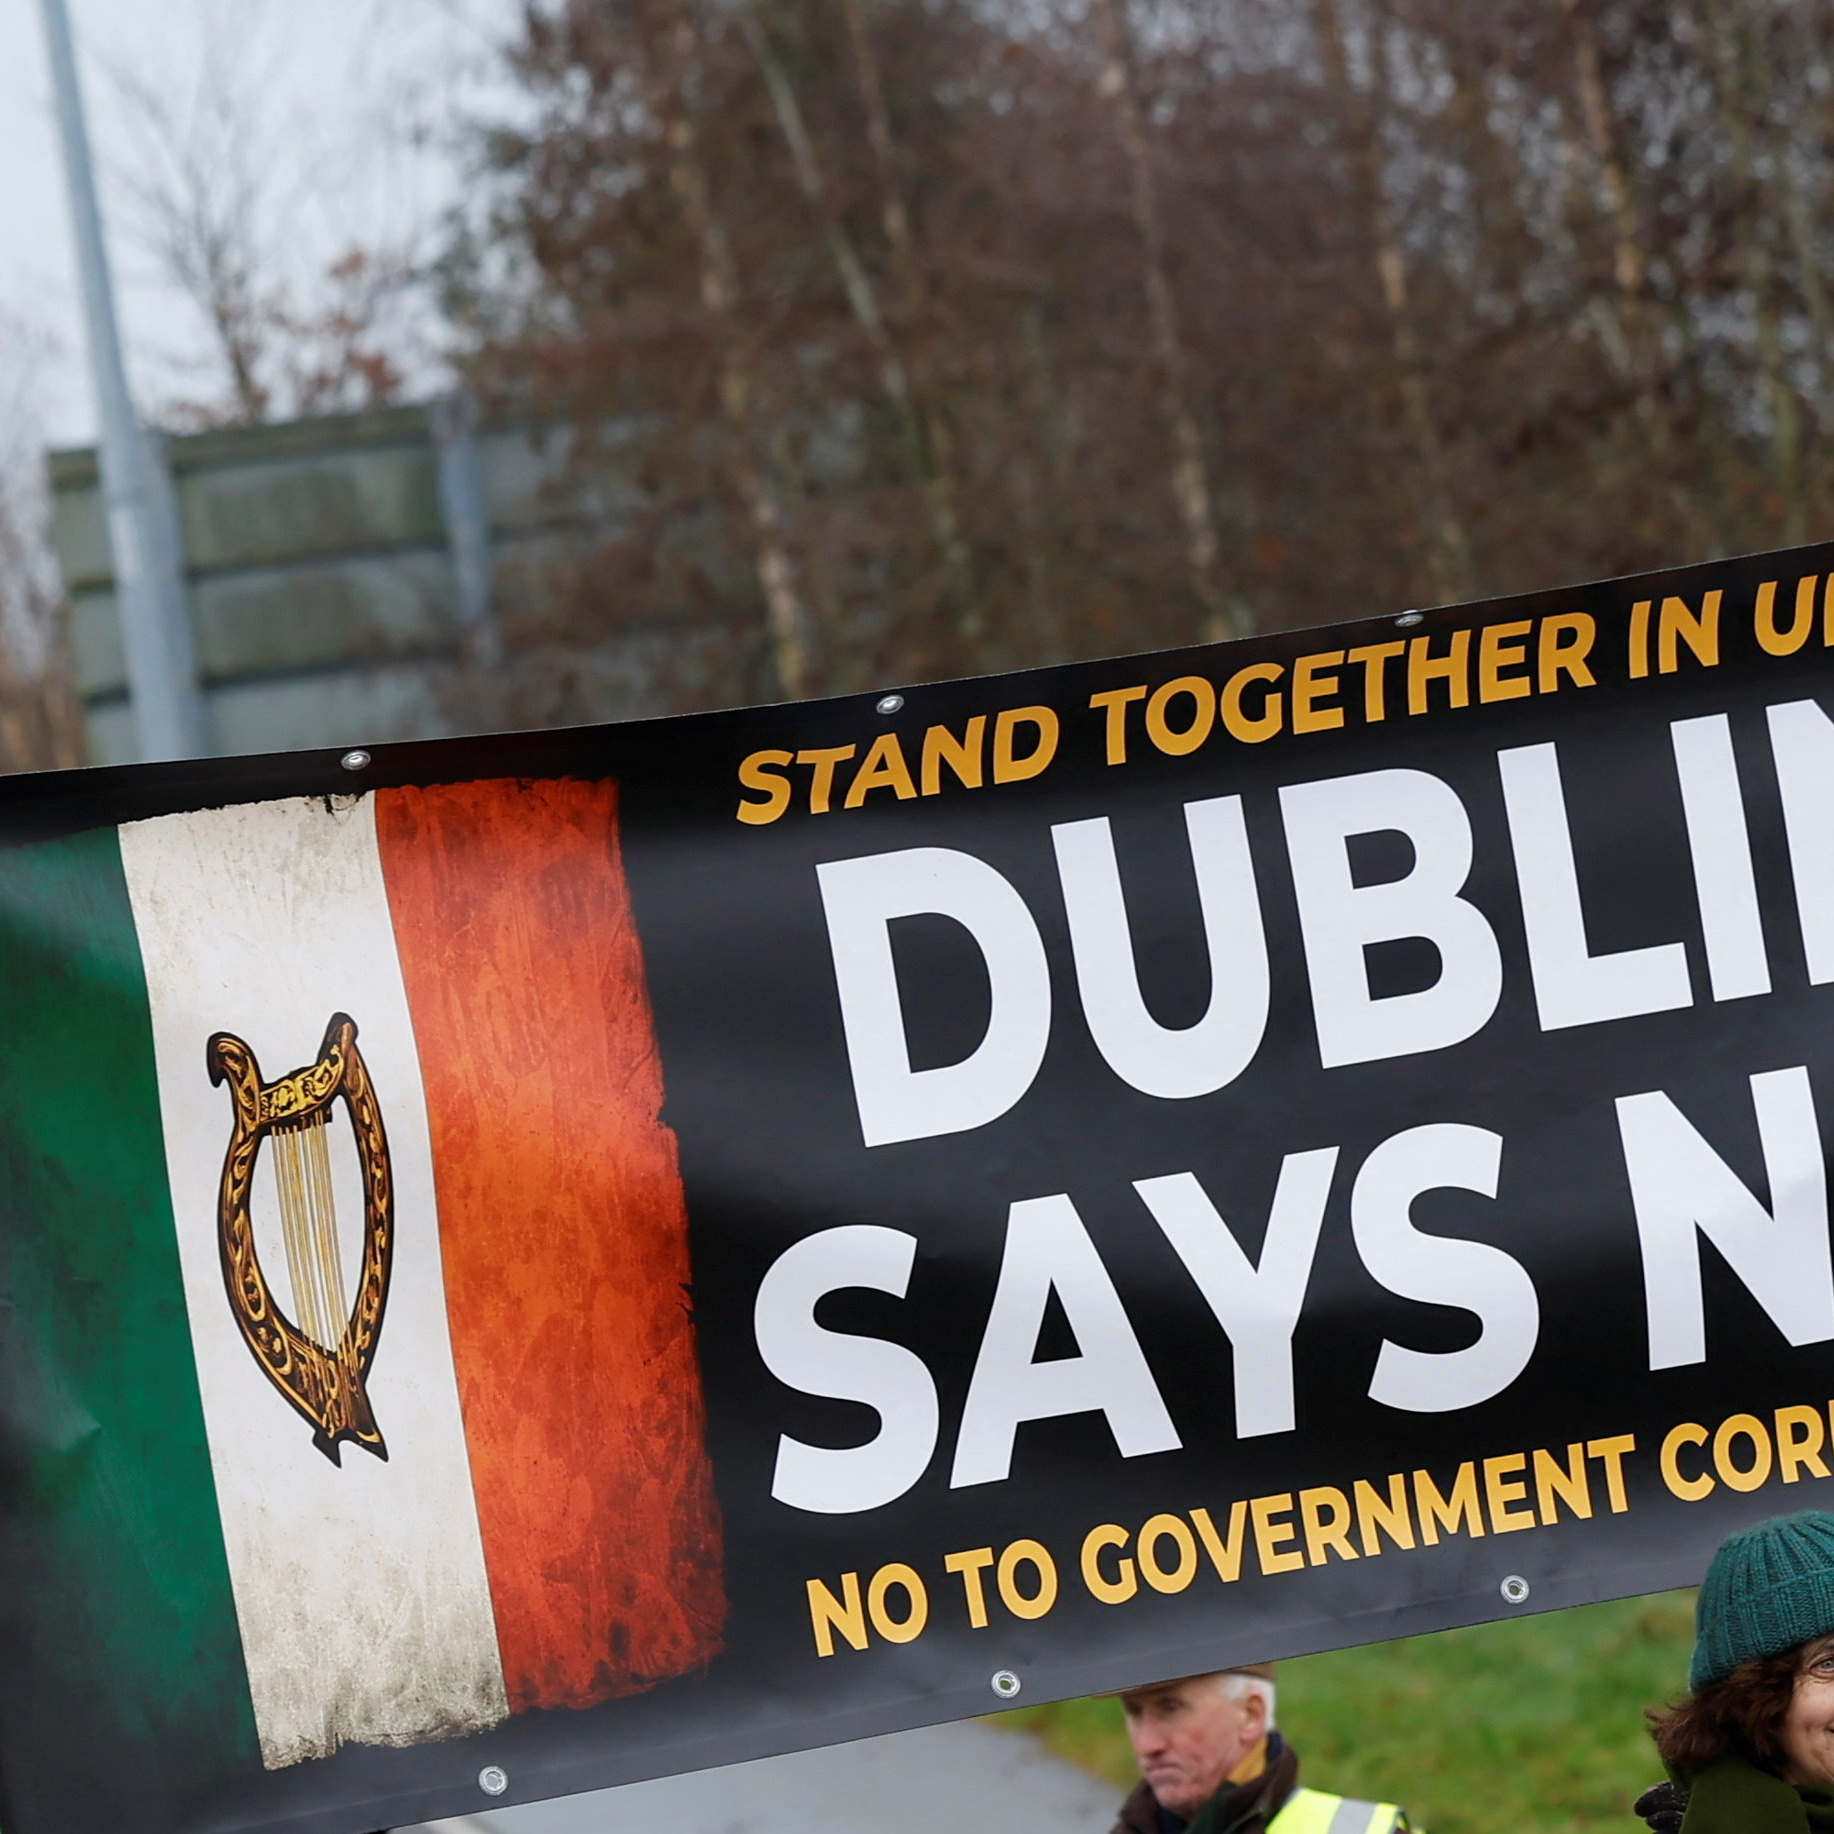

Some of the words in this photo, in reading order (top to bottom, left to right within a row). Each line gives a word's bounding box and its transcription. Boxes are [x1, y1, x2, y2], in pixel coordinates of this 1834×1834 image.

[734, 703, 1061, 827] STAND
[1087, 616, 1599, 768] TOGETHER
[1627, 587, 1725, 681] IN
[752, 1120, 1542, 1516] SAYS
[804, 1560, 930, 1658] NO
[943, 1537, 1060, 1628] TO
[1079, 1431, 1638, 1605] GOVERNMENT
